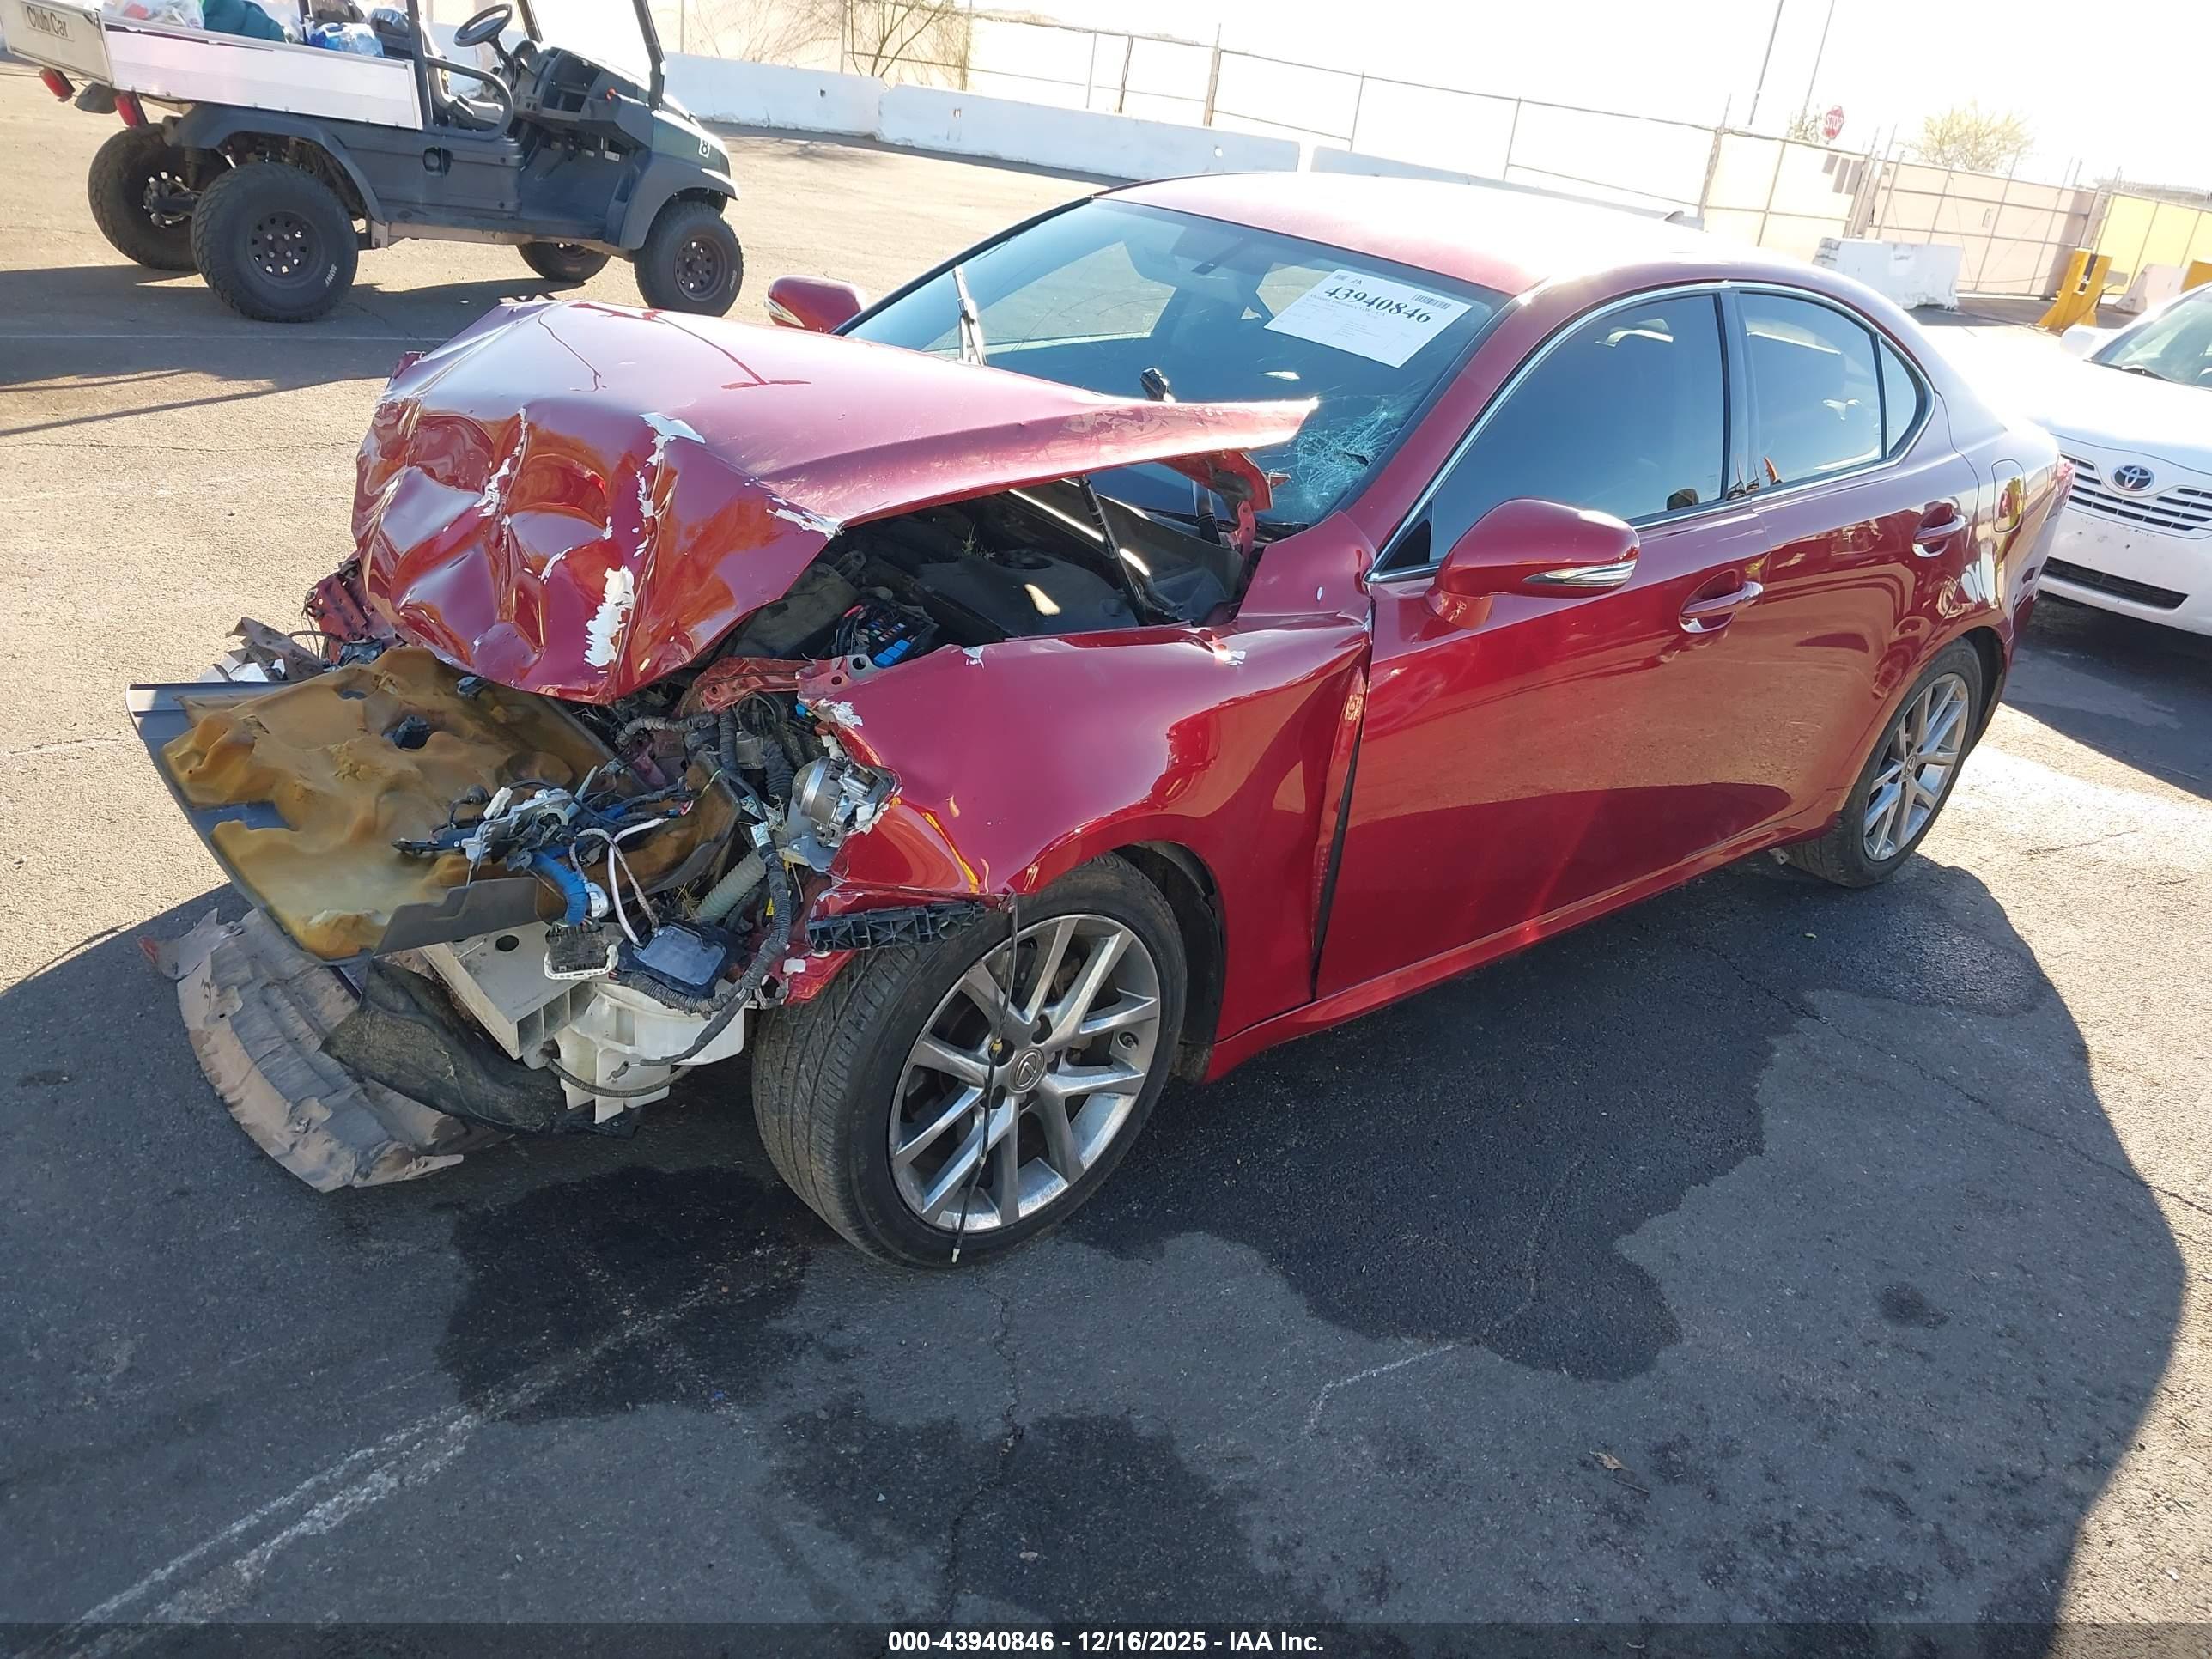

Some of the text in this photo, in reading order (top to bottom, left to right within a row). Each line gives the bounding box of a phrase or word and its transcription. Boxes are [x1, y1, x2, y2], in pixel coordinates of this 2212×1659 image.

[27, 6, 68, 37] Club Car
[1826, 115, 1844, 130] STOP
[701, 139, 708, 155] 8
[1324, 286, 1435, 323] 43940846
